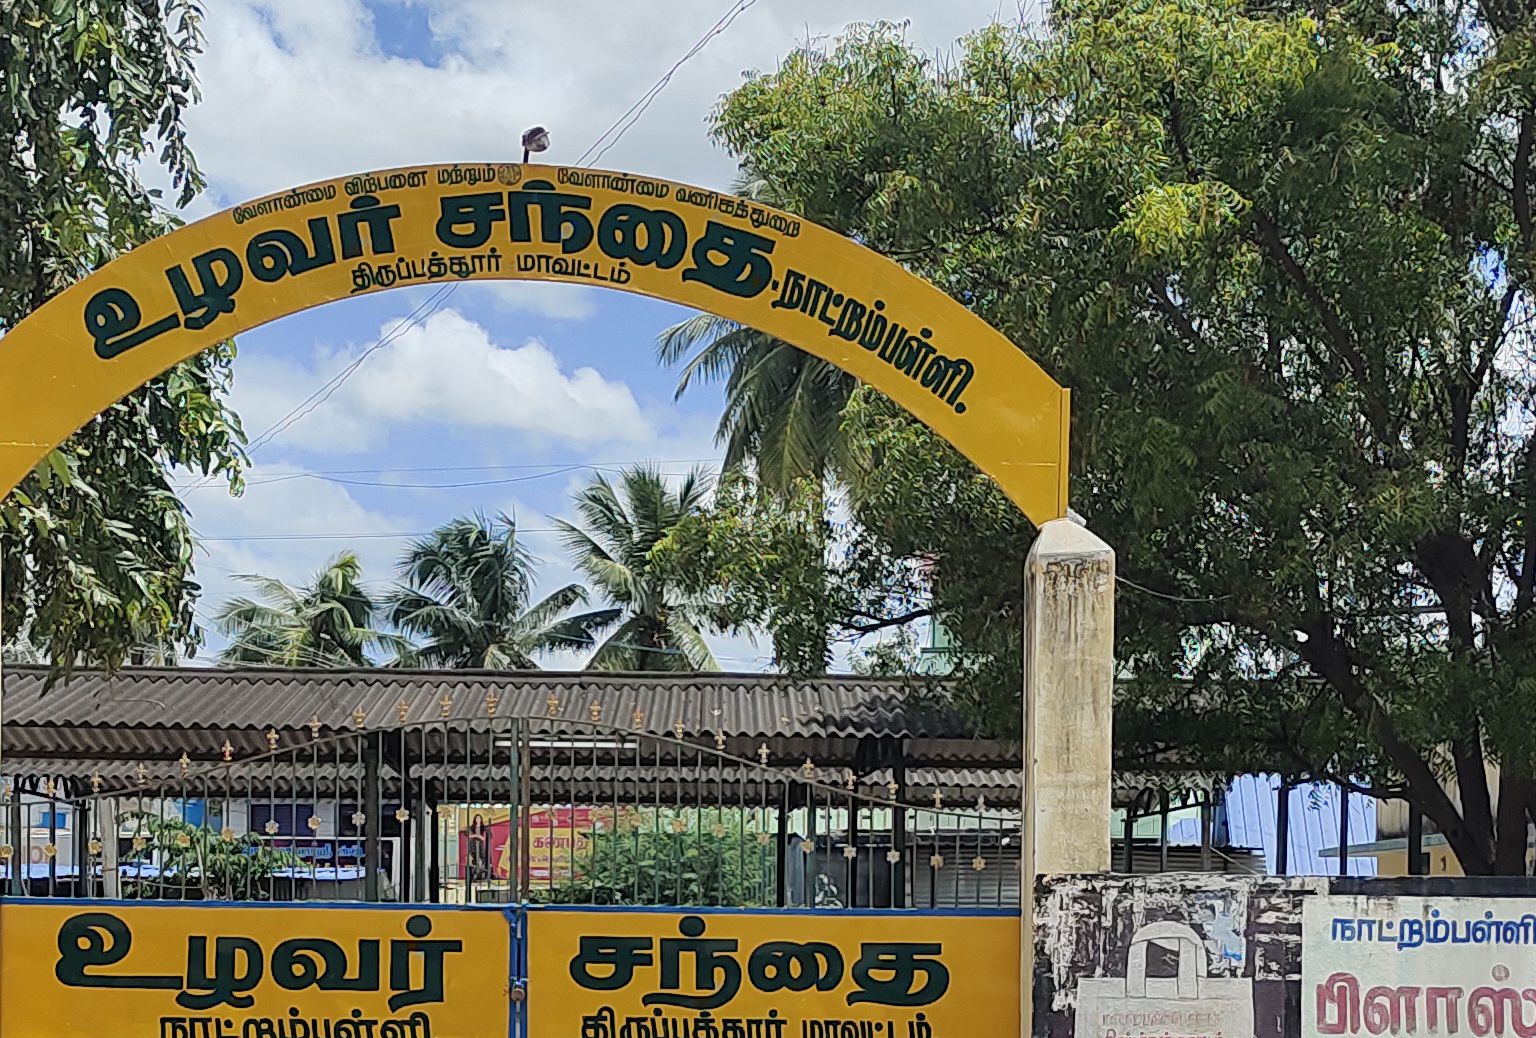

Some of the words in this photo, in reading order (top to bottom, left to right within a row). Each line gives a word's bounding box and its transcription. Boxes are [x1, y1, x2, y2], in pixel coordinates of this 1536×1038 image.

[232, 185, 337, 225] வேளாண்மை
[437, 163, 495, 186] மற்றும்
[557, 167, 669, 199] வேளாண்மை
[83, 195, 402, 360] உழவர்
[350, 247, 503, 294] திருப்பத்தூர்
[517, 253, 631, 285] மாவட்டம்
[54, 912, 462, 1013] உழவர்
[569, 915, 950, 1010] சந்தை
